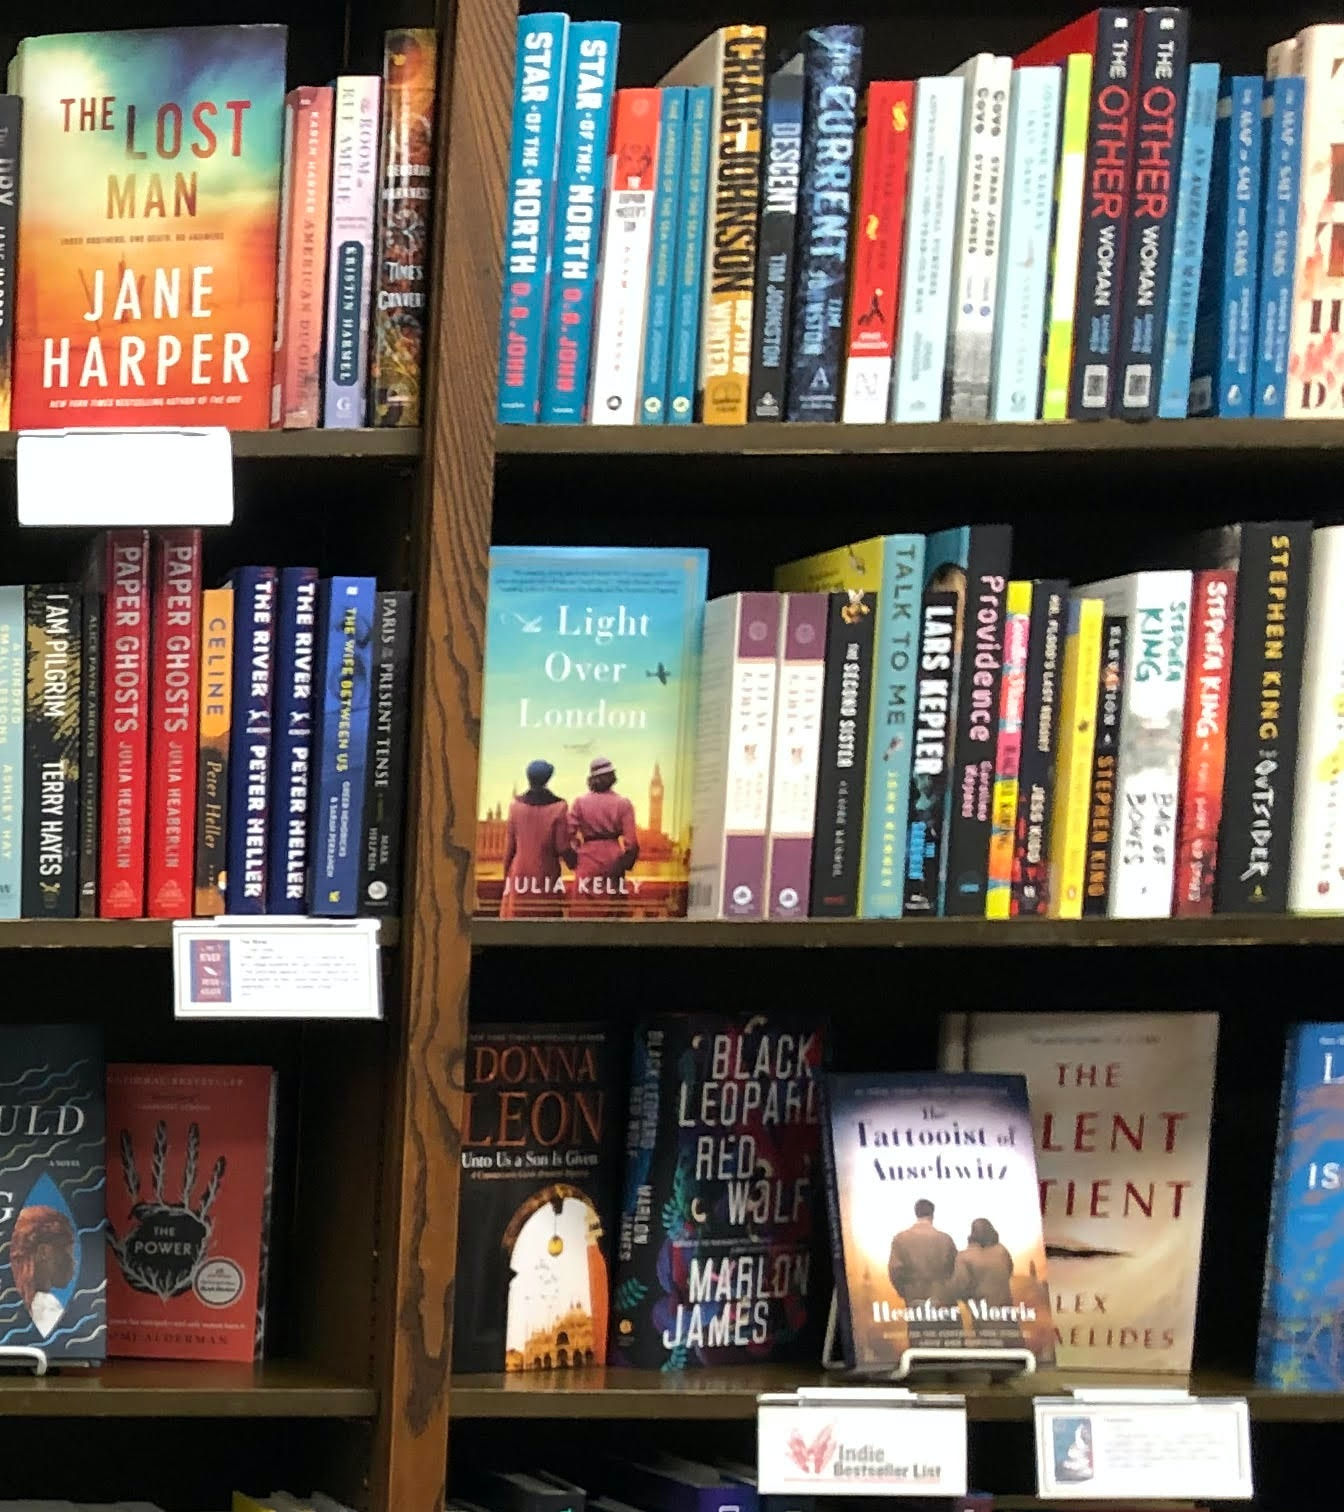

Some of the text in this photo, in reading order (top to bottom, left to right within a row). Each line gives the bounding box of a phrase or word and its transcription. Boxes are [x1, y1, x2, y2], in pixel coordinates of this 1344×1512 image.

[60, 96, 250, 161] THE LOST
[714, 36, 764, 293] CRAIG JOHNSON
[767, 122, 800, 215] DESCENT
[1092, 41, 1130, 307] THE OTHER WOMAN
[107, 171, 198, 219] MAN
[83, 266, 213, 322] JANE
[42, 334, 250, 388] HARPER
[165, 545, 193, 733] PAPER GHOSTS
[559, 604, 650, 647] Light
[545, 652, 627, 682] Over
[915, 605, 953, 775] LARS KEPLER
[519, 699, 648, 729] London
[504, 876, 643, 896] JULIA KELLY
[475, 1046, 598, 1083] DONNA
[462, 1090, 605, 1147] LEON
[134, 1240, 192, 1256] POWER
[153, 1225, 176, 1237] THE
[662, 1301, 770, 1351] JAMES
[872, 1299, 1037, 1323] Heather Morris
